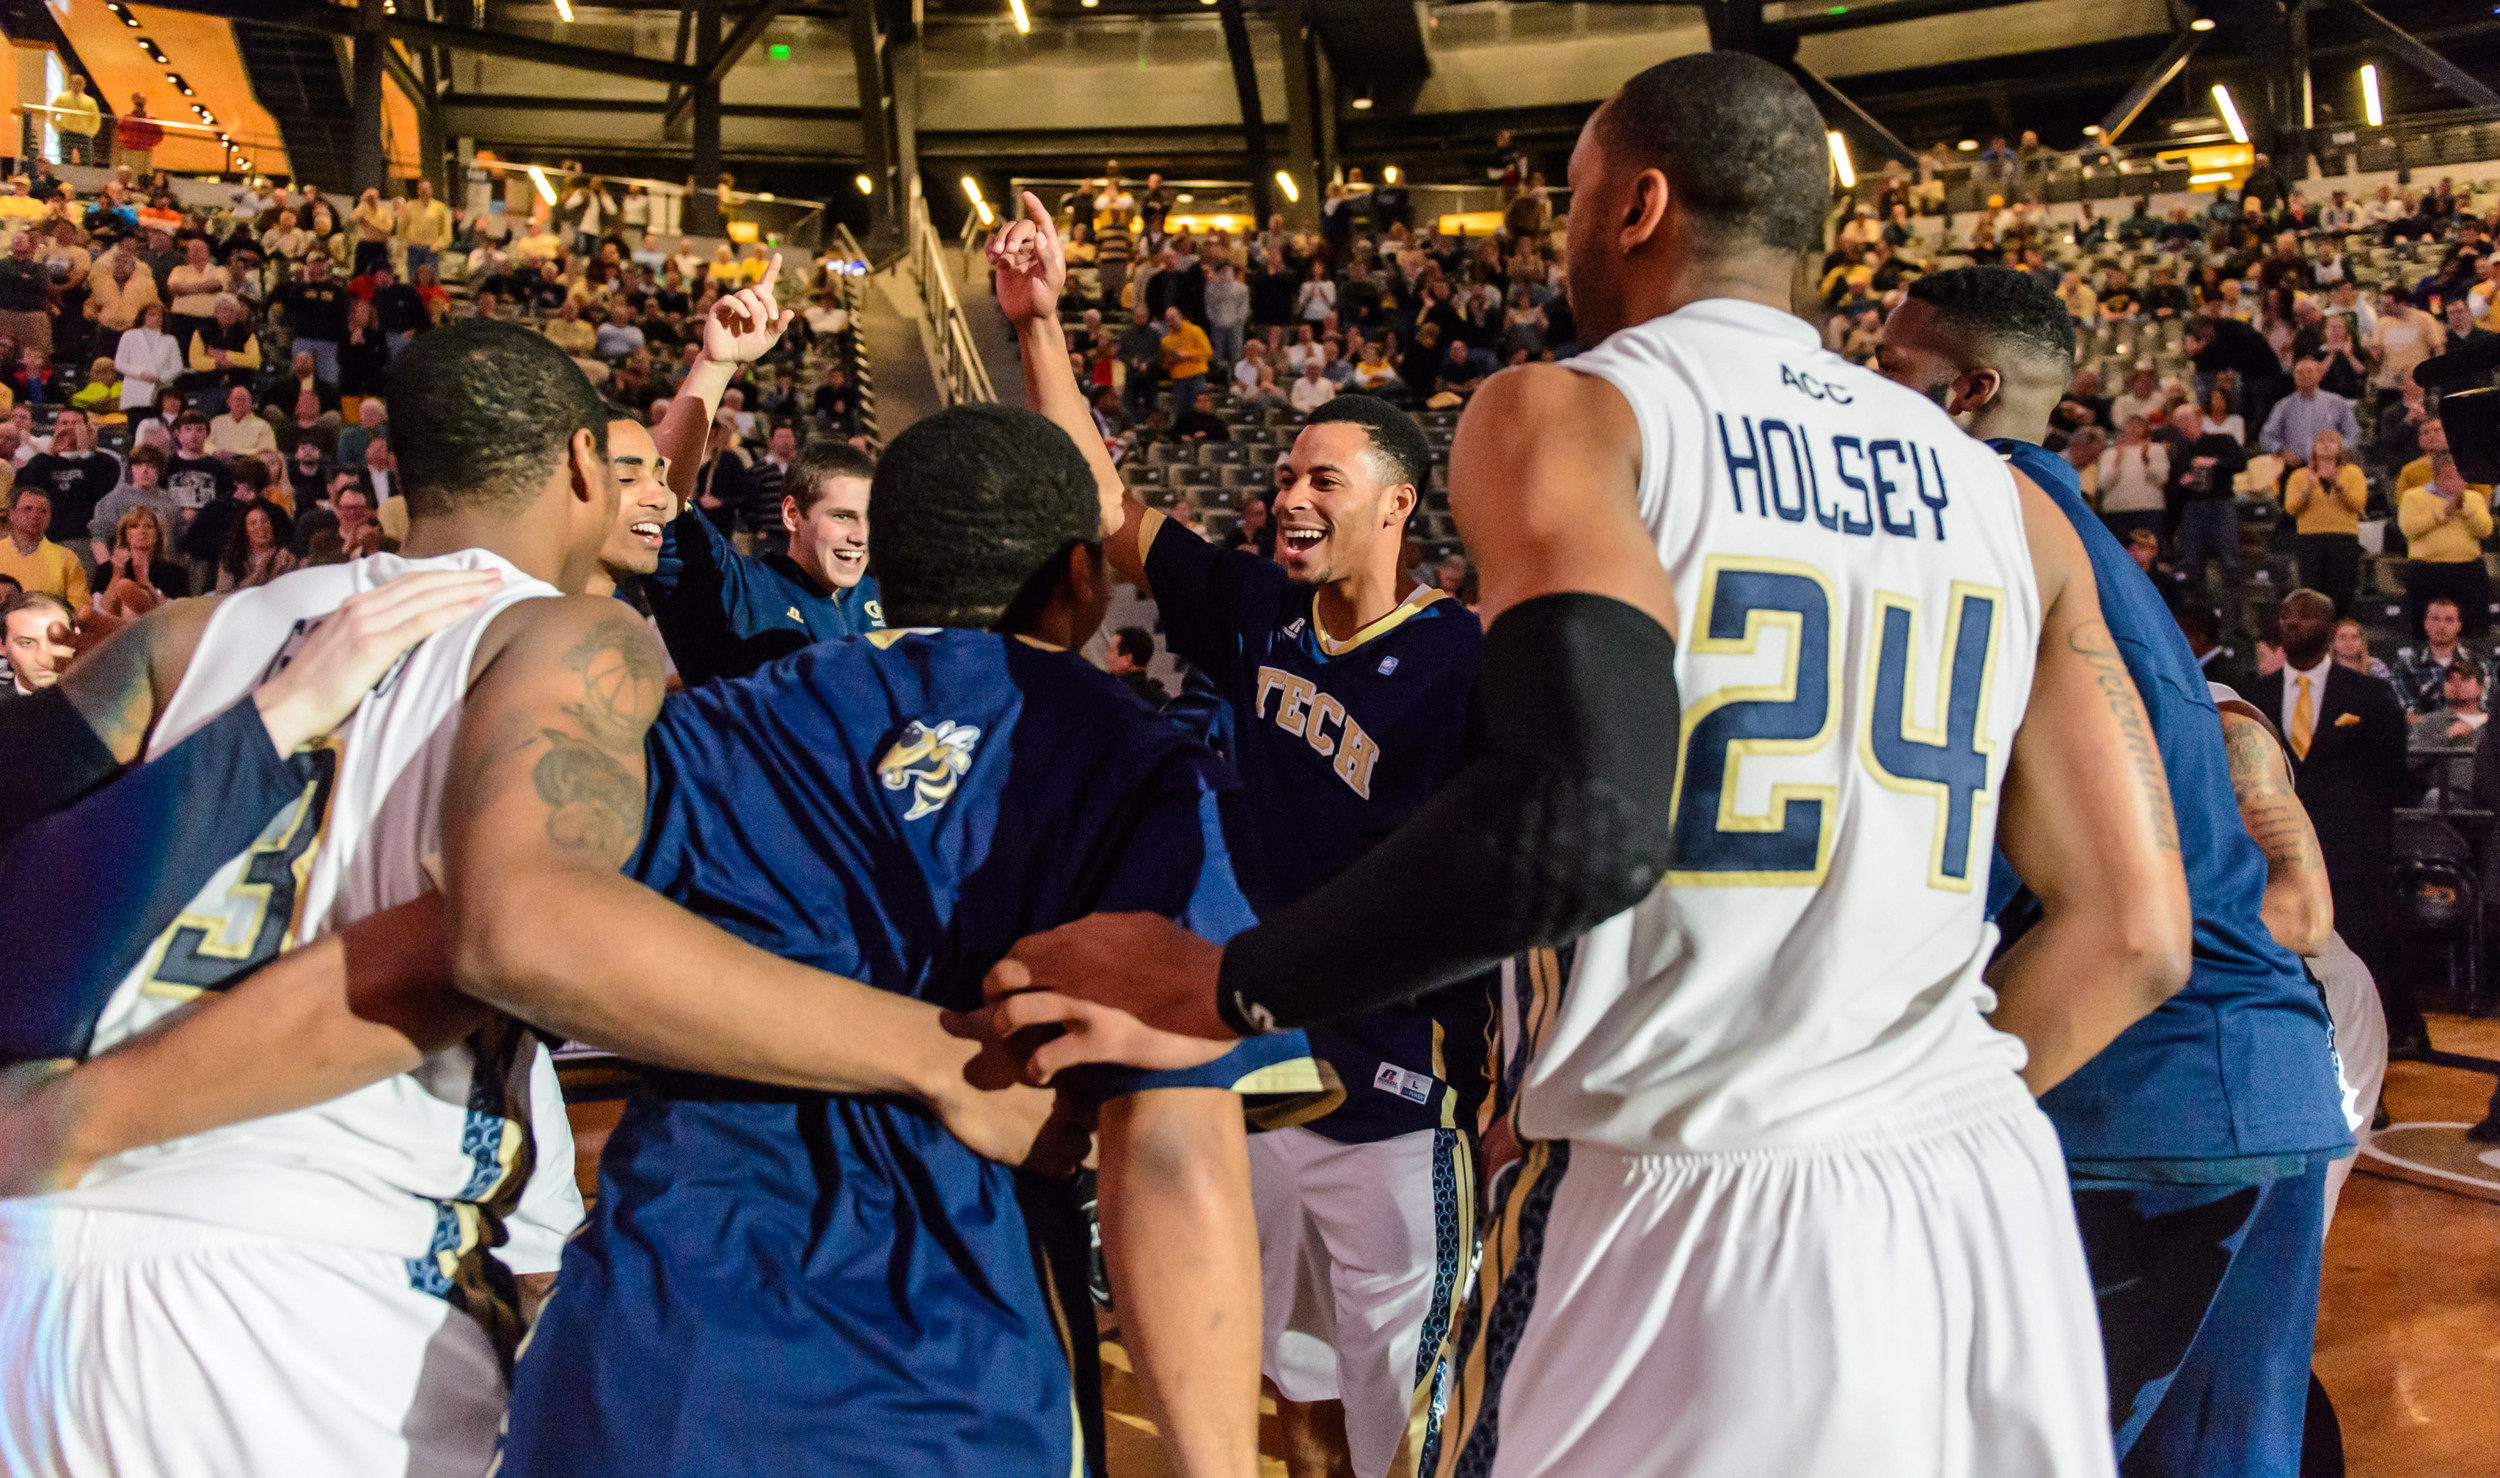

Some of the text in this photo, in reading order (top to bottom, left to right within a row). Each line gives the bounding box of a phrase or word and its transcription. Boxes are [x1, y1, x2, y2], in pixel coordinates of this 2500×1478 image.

[1780, 362, 1854, 405] ACC
[1716, 411, 1949, 541] HOLSEY
[1256, 665, 1380, 800] TECH
[1664, 553, 2004, 893] 24
